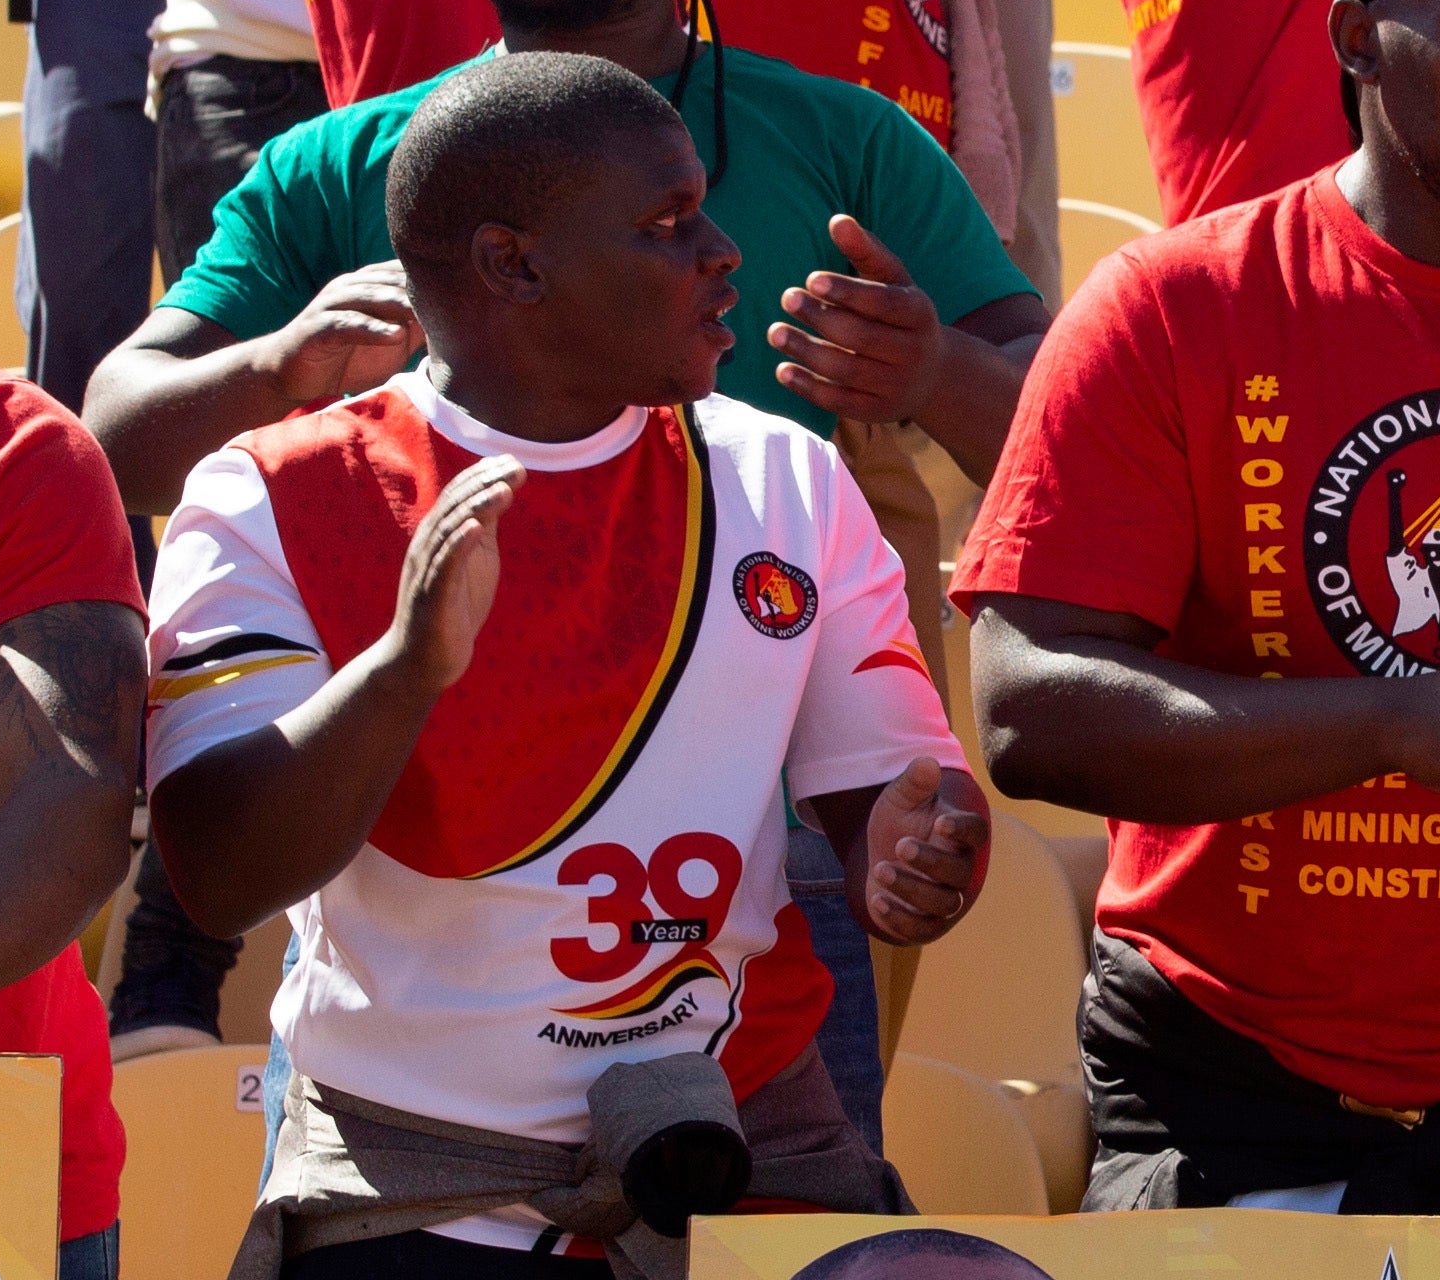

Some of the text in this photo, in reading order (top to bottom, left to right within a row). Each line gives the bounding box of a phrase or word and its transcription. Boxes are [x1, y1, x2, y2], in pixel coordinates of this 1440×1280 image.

[736, 554, 774, 588] NATIONAL
[1317, 564, 1362, 622] OF
[740, 598, 752, 613] OF
[776, 597, 817, 637] WORKERS
[550, 831, 744, 984] 39
[640, 922, 701, 941] Years
[537, 991, 700, 1049] ANNIVERSARY
